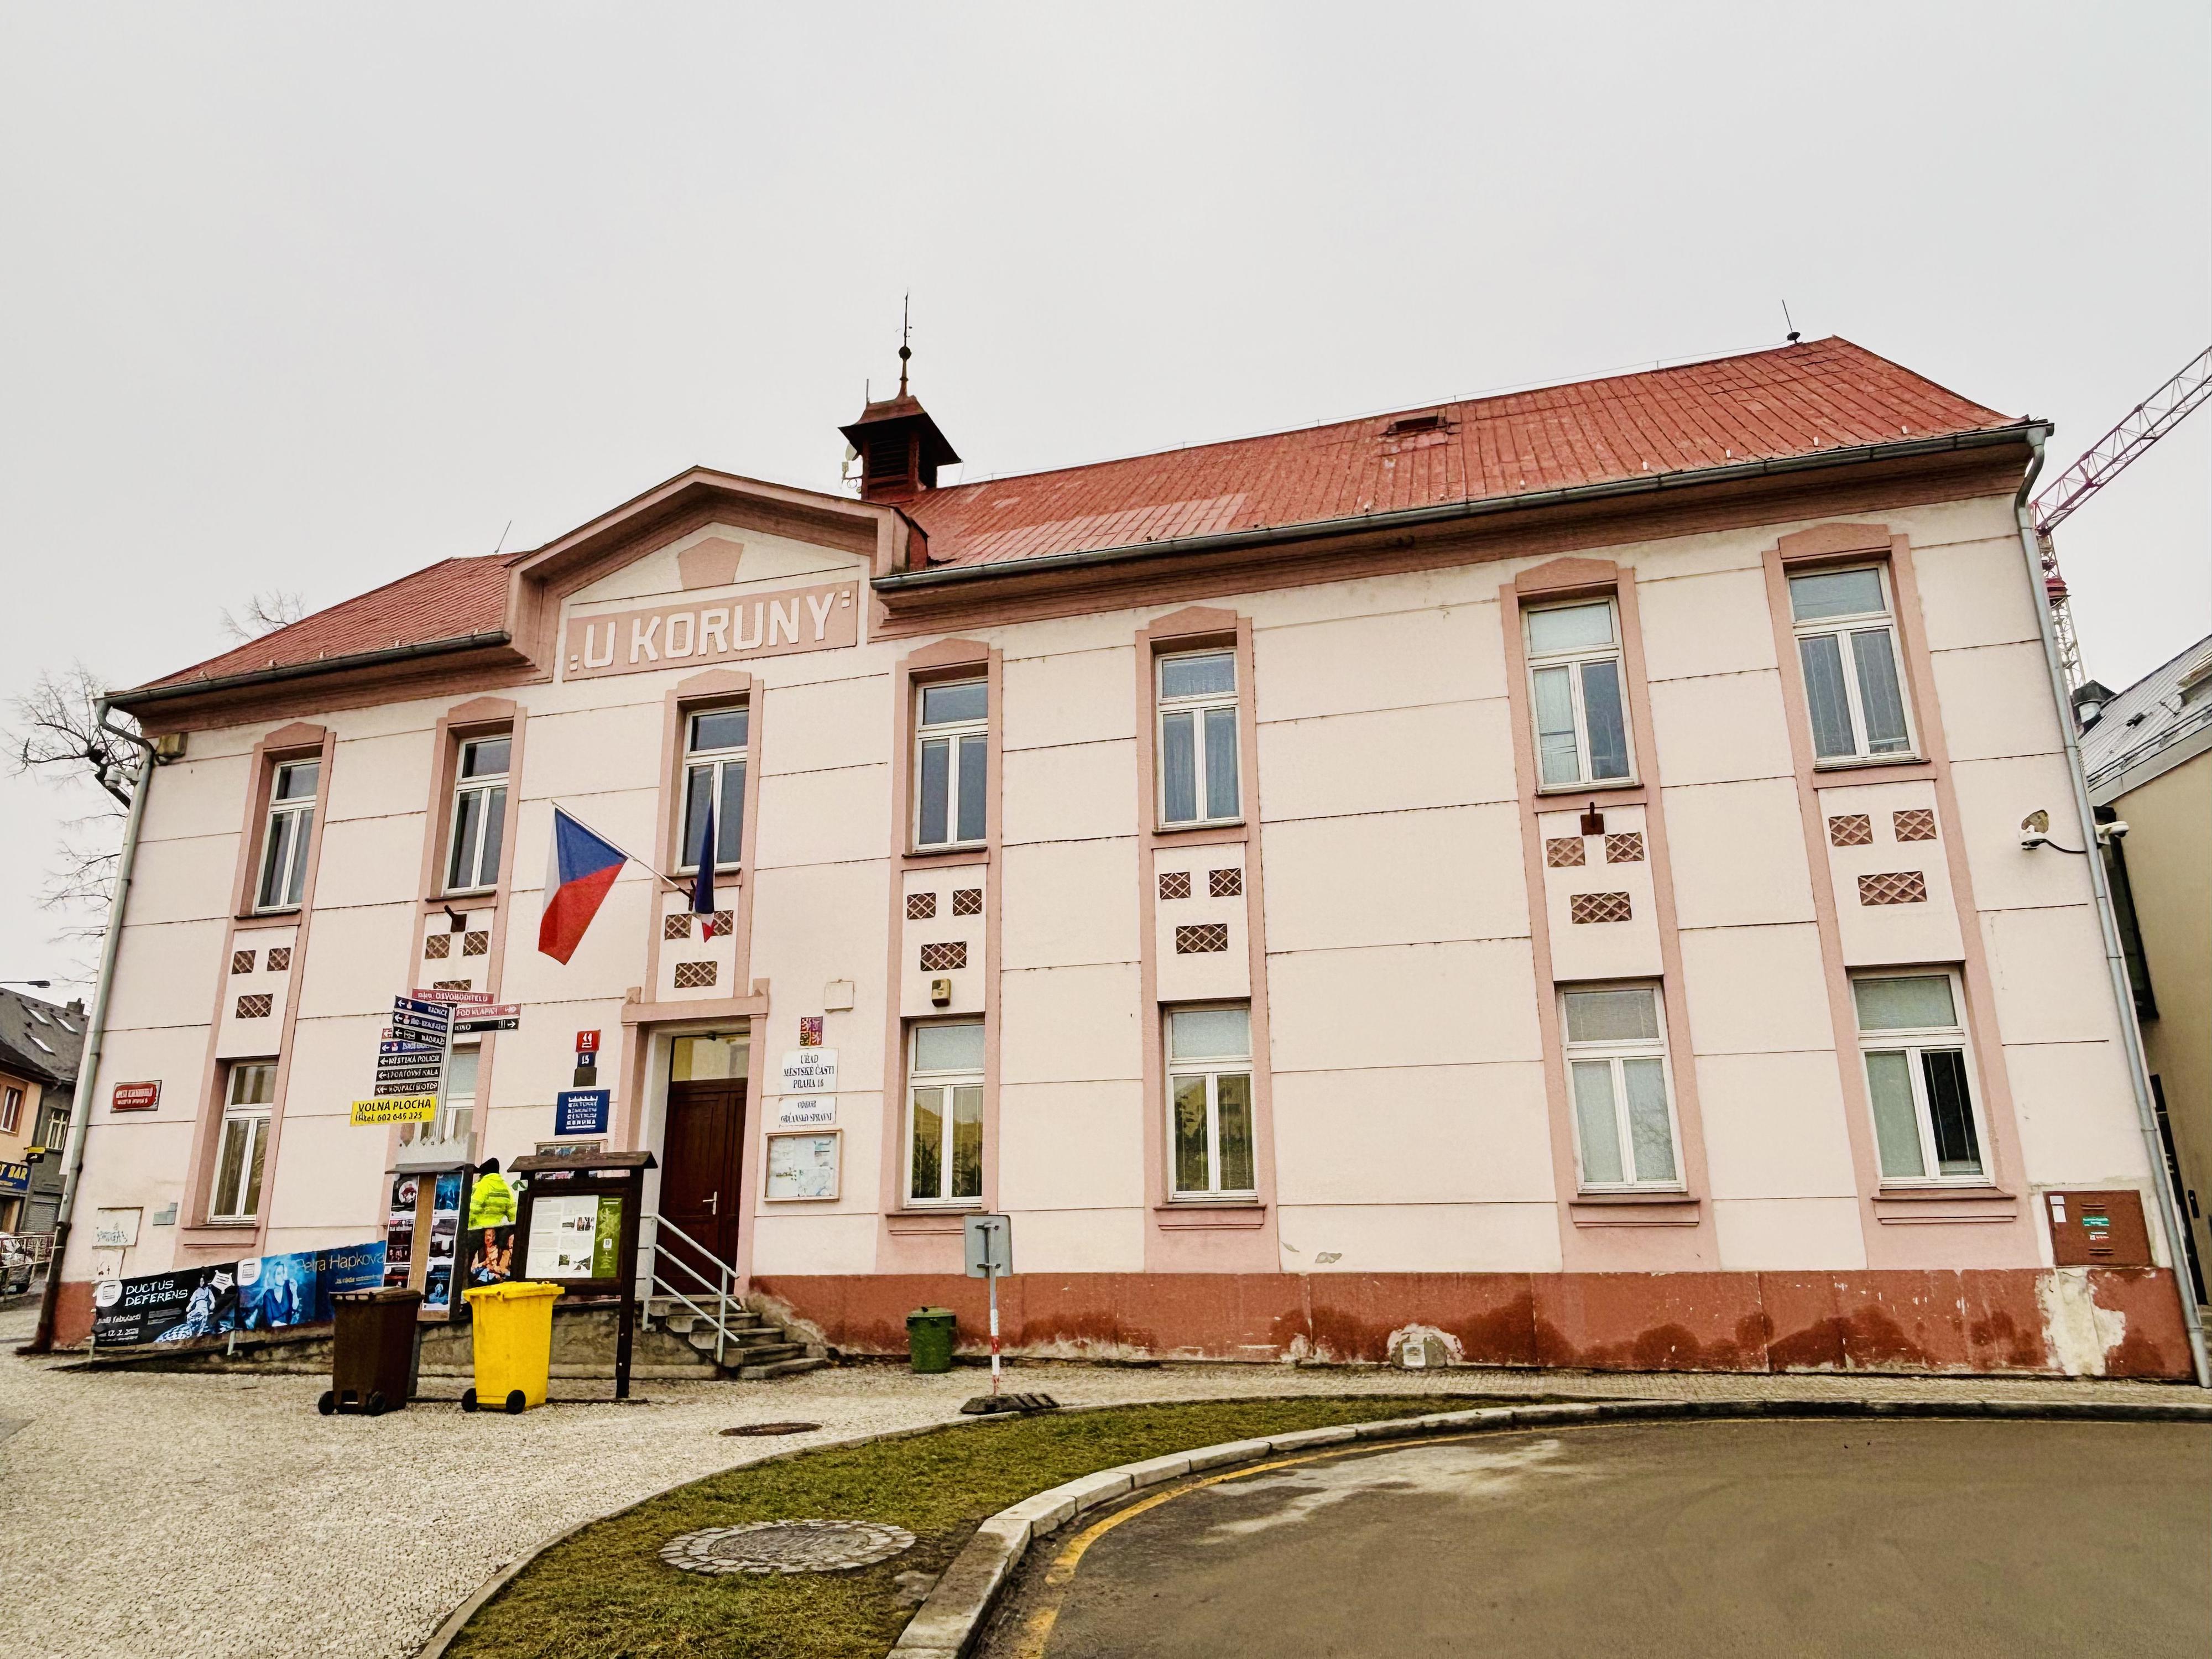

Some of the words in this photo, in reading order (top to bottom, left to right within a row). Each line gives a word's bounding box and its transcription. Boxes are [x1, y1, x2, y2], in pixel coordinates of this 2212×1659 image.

[393, 1099, 431, 1110] PLOCHA
[8, 1165, 28, 1181] BAR
[126, 1280, 175, 1295] DUCTUS
[124, 1289, 189, 1307] DEFERENS
